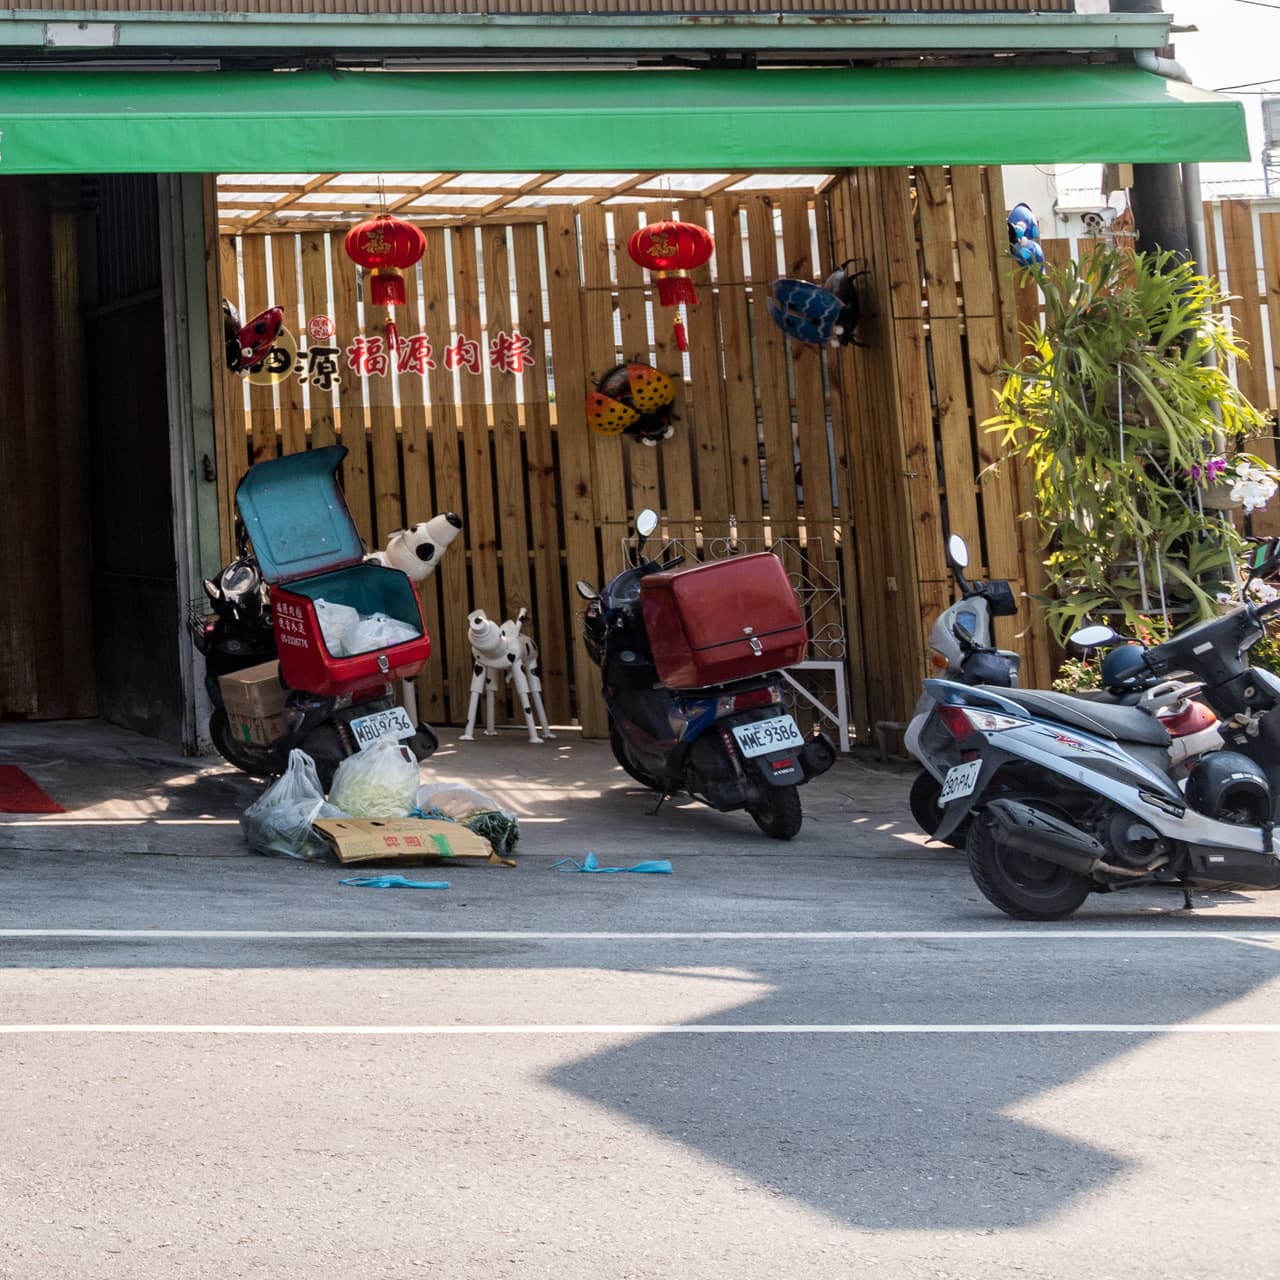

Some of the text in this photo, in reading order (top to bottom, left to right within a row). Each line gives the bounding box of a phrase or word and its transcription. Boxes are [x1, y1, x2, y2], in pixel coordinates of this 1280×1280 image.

[346, 331, 536, 377] 福源肉粽
[738, 723, 799, 751] MME-9386
